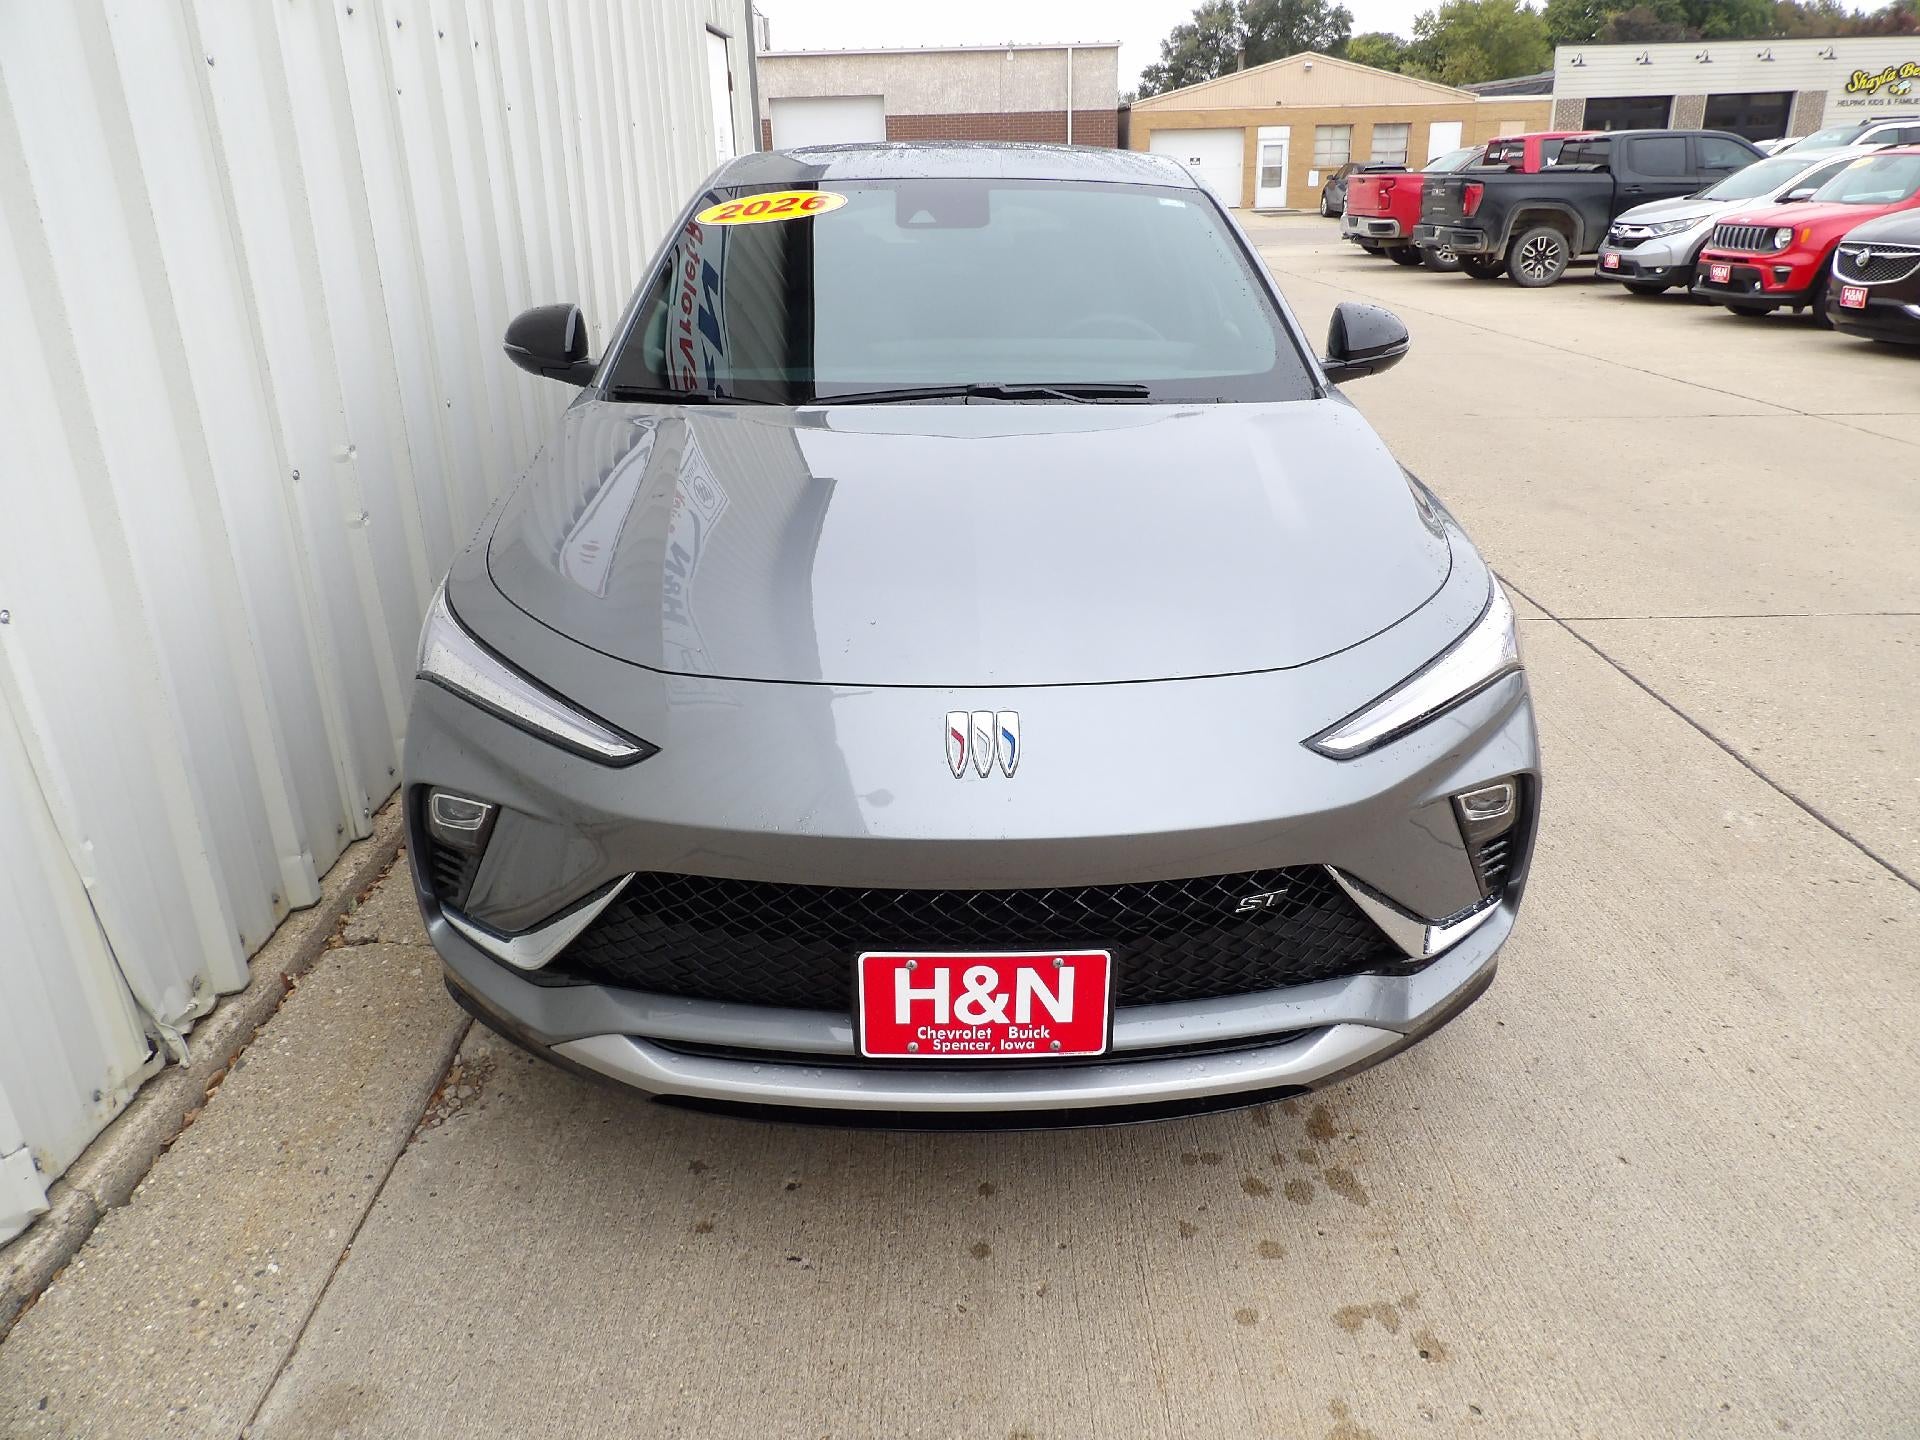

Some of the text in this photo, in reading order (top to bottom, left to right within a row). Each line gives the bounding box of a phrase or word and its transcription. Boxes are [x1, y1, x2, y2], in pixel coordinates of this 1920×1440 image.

[711, 195, 830, 222] 2026
[1844, 288, 1864, 302] H&N
[1235, 888, 1289, 913] ST
[894, 965, 1075, 1025] H&N
[917, 1025, 1050, 1039] Chevrolet Buick
[933, 1039, 1035, 1052] Spencer, Iowa
